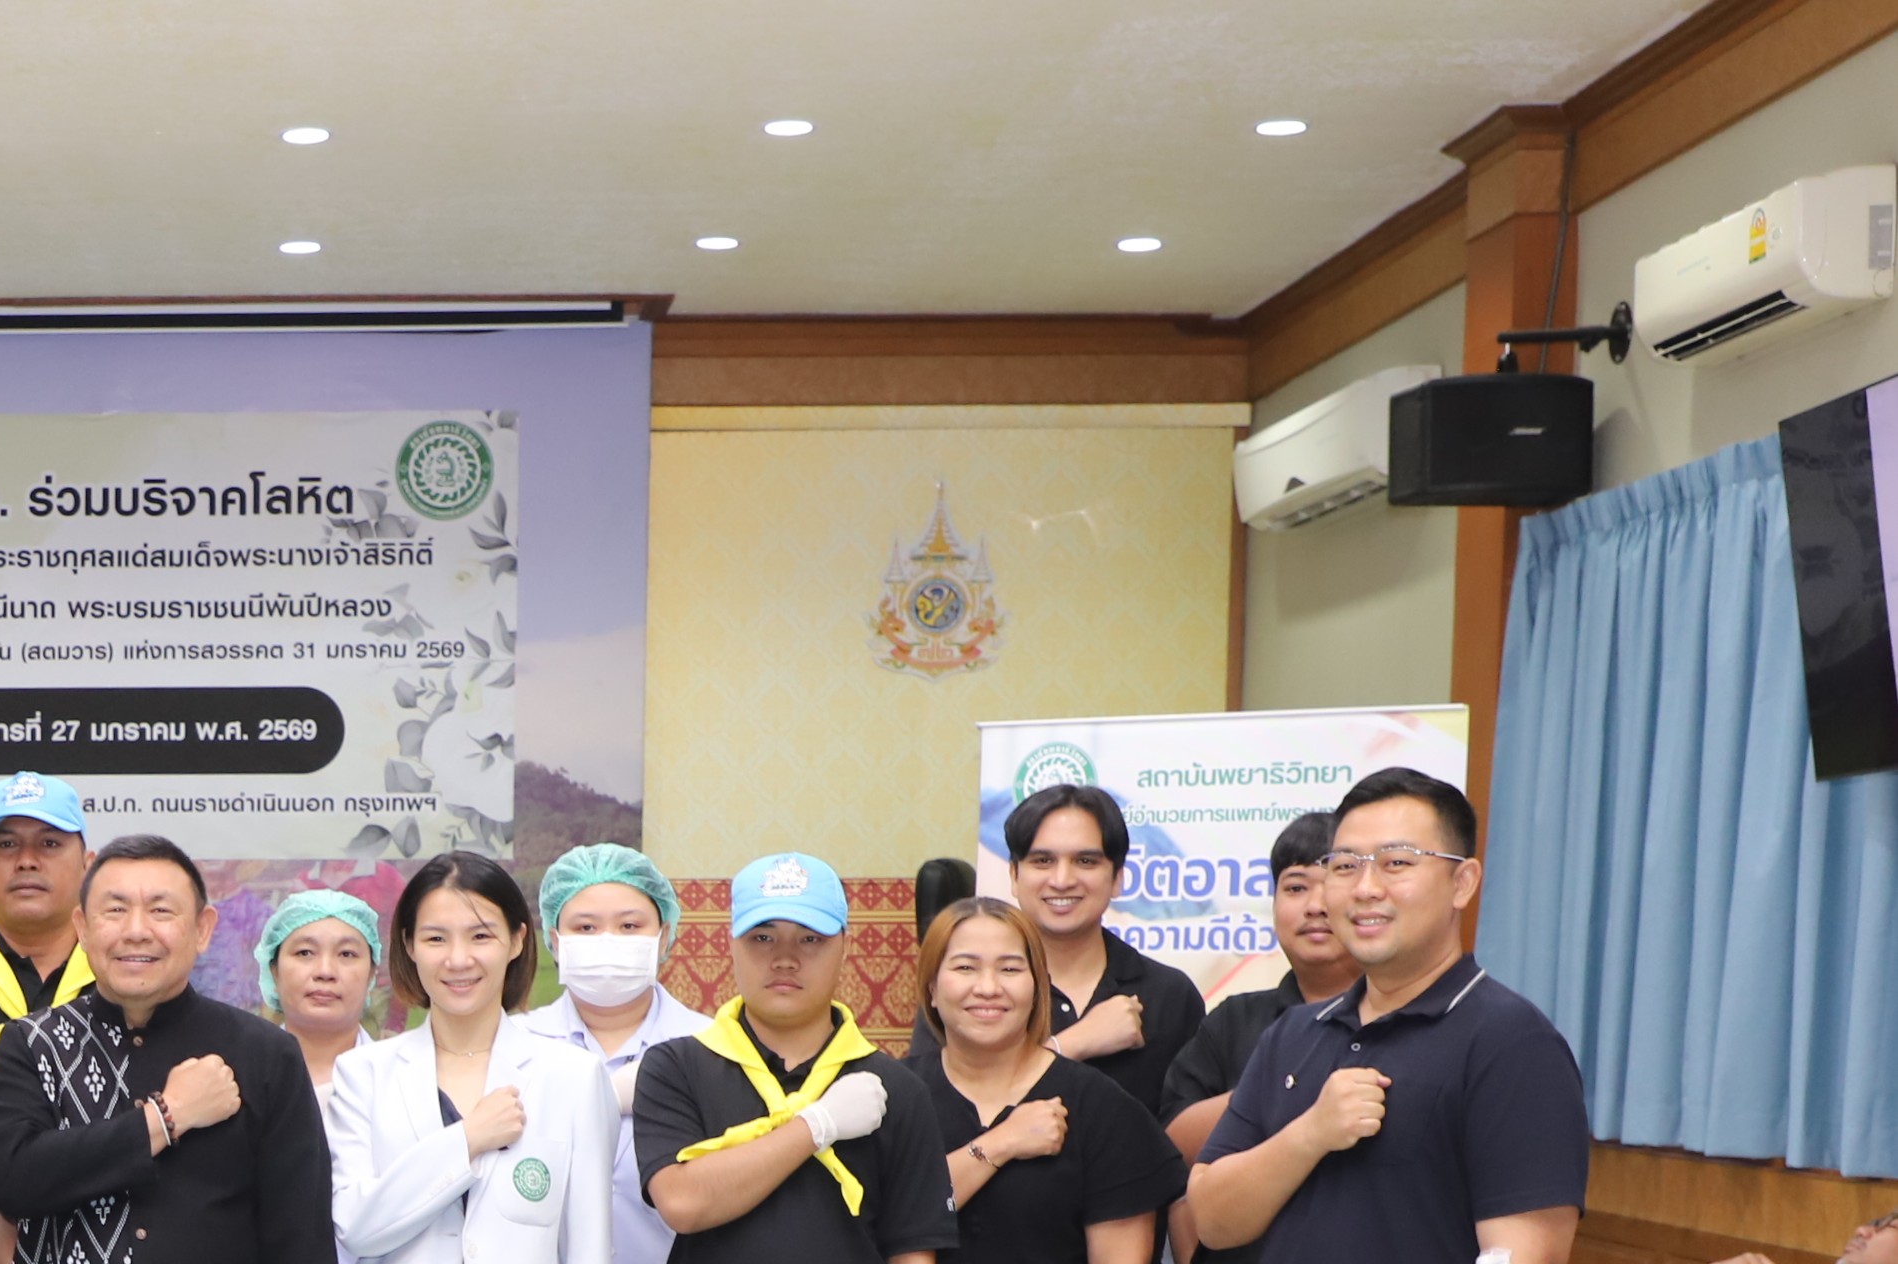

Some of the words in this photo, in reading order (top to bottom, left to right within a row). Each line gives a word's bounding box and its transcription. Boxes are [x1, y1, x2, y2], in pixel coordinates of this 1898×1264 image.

[28, 472, 353, 518] ร่วมบริจาคโลหิต
[68, 592, 392, 619] พระบรมราชชนนีพันปีหลวง
[123, 639, 284, 660] แห่งการสวรรคต
[293, 642, 316, 659] 31
[326, 641, 407, 660] มกราคม
[416, 641, 466, 659] 2569
[51, 720, 80, 742] 27
[90, 719, 186, 742] มกราคม
[195, 720, 249, 742] พ.ศ.
[258, 719, 318, 742] 2569
[1136, 761, 1353, 788] สถาบันพยาธิวิทยา
[82, 796, 143, 813] ส.ป.ก.
[152, 791, 335, 813] ถนนราชดำเนินนอก
[344, 796, 437, 818] กรุงเทพฯ
